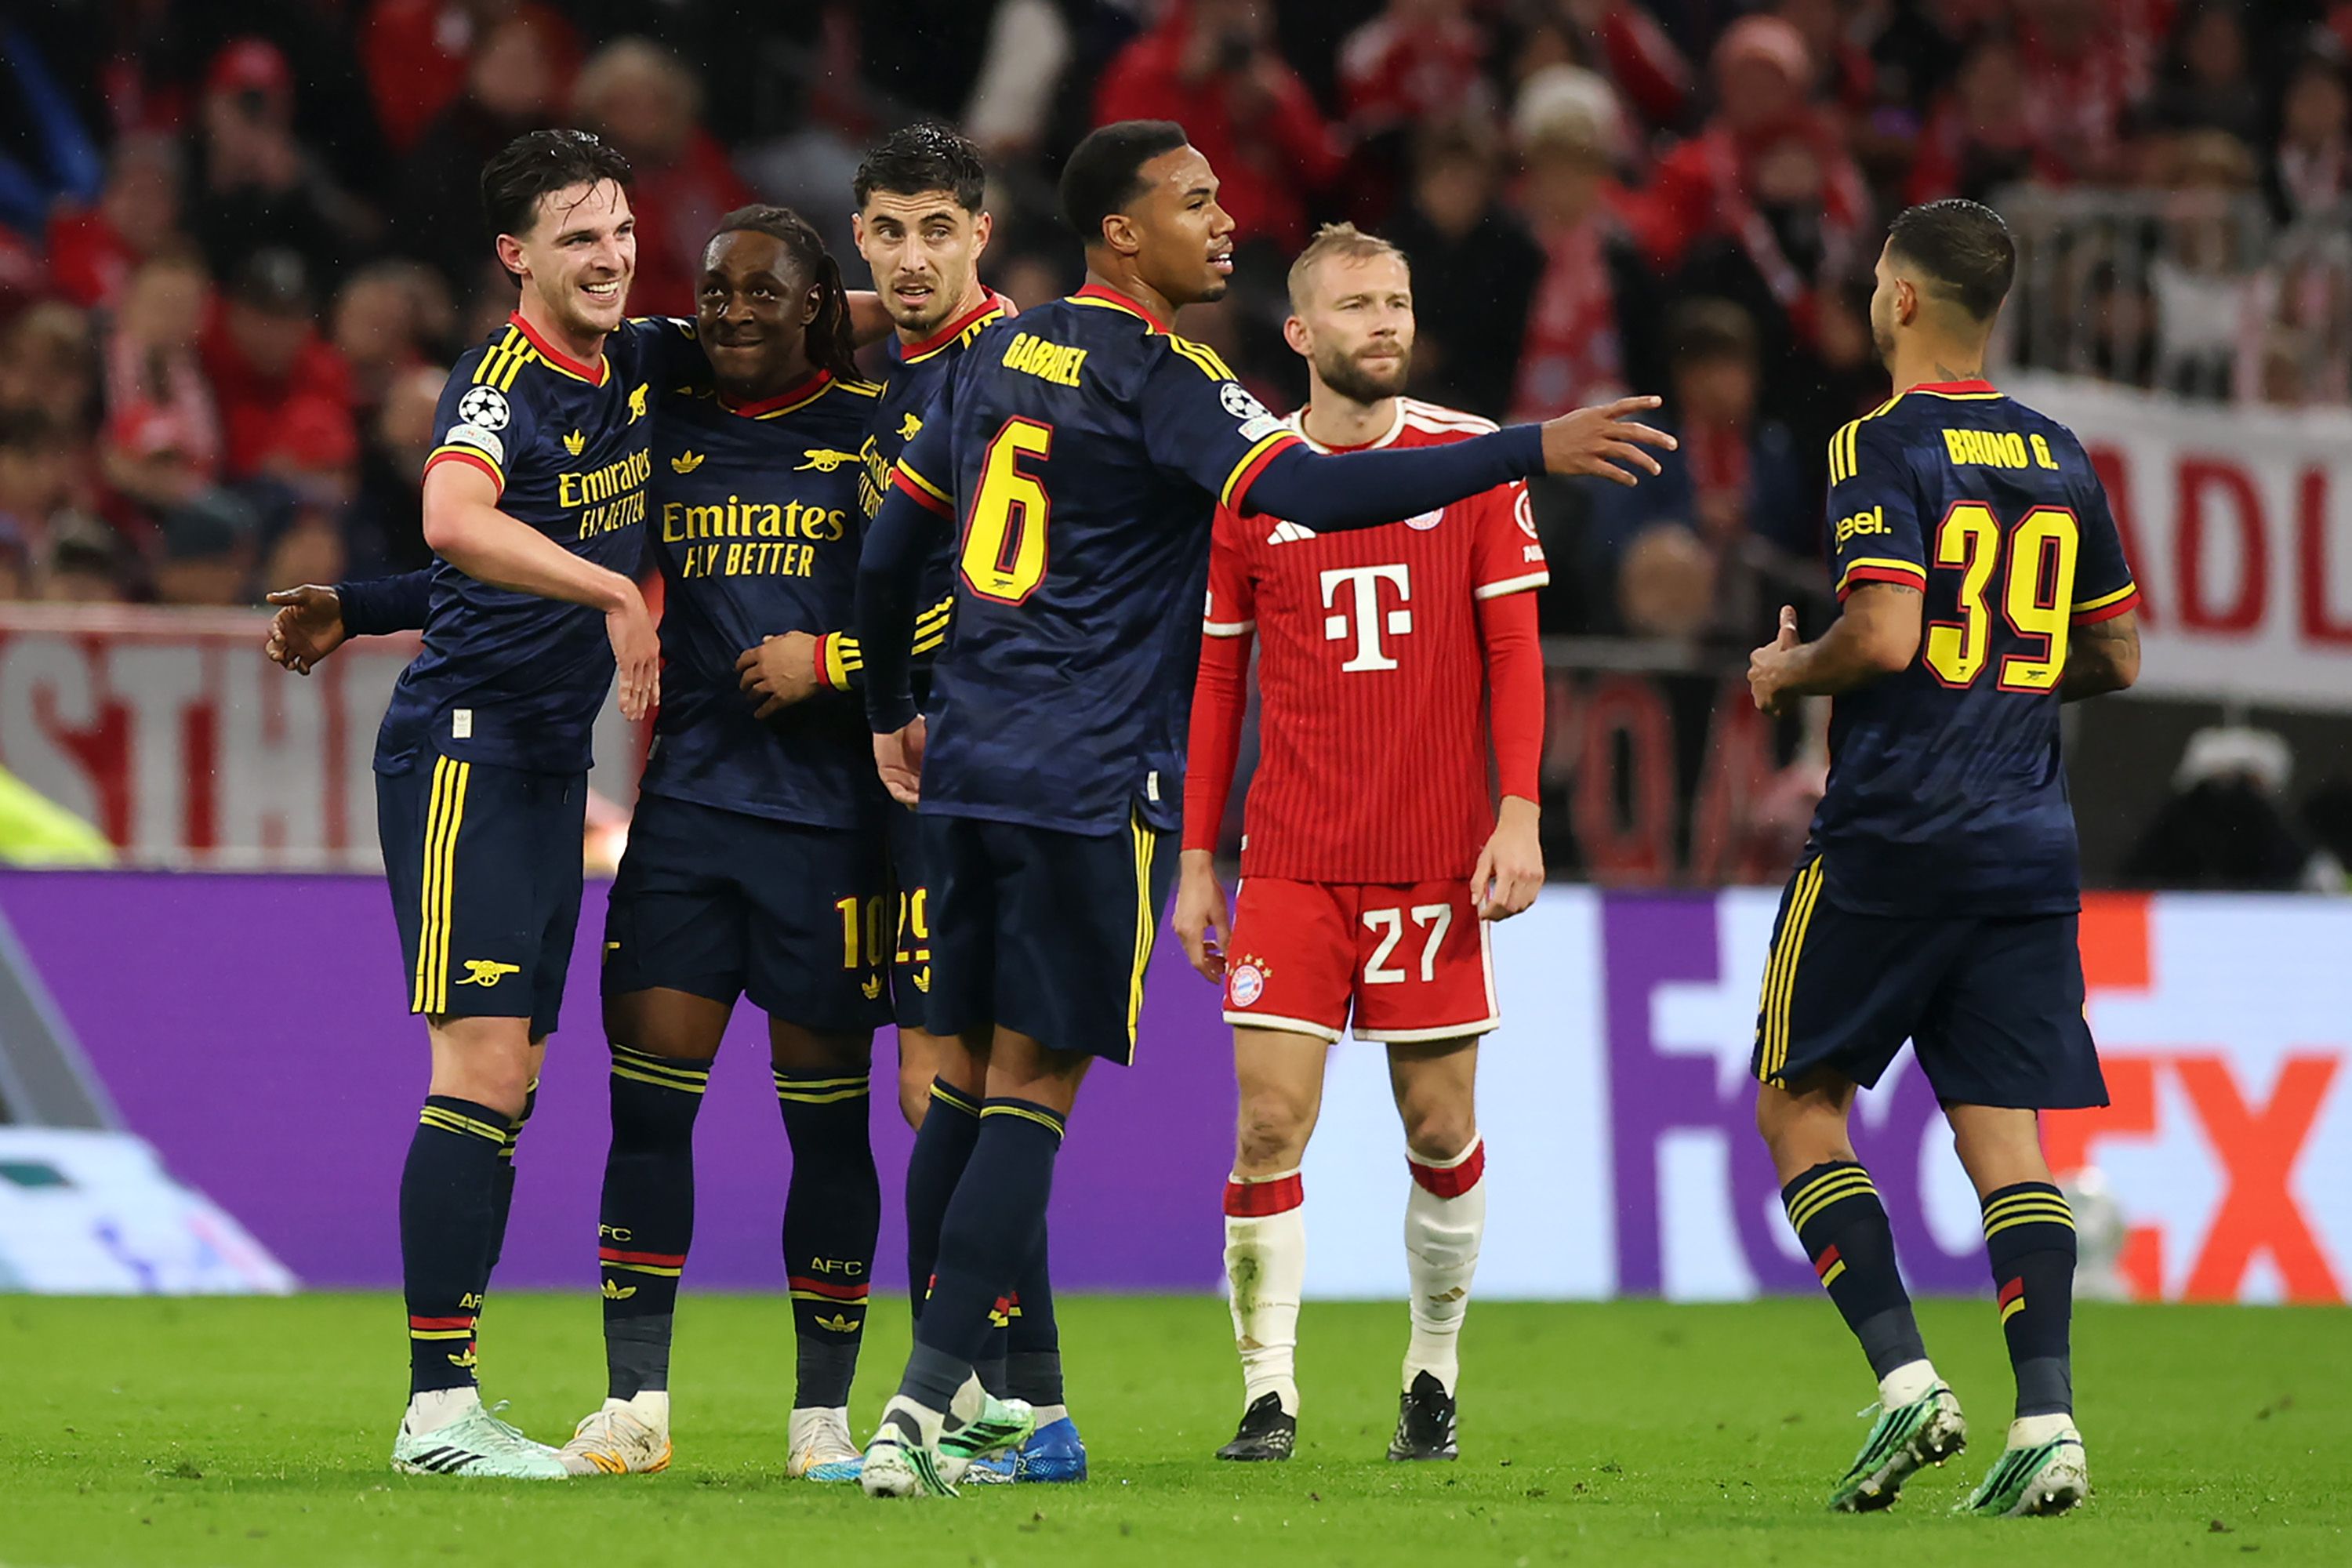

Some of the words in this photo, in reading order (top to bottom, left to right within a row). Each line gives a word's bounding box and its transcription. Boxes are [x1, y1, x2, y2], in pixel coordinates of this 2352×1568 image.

[1002, 332, 1087, 387] GABRIEL
[1941, 429, 2028, 469] BRUNO
[2029, 434, 2059, 470] G.
[558, 448, 650, 507] Emirates
[663, 495, 846, 543] Emirates
[960, 415, 1054, 606] 6
[683, 544, 720, 578] FLY
[724, 543, 815, 578] BETTER
[1922, 499, 2079, 695] 39
[836, 896, 884, 969] 10
[1363, 903, 1451, 984] 27
[598, 1223, 632, 1242] FC
[811, 1257, 862, 1276] AFC
